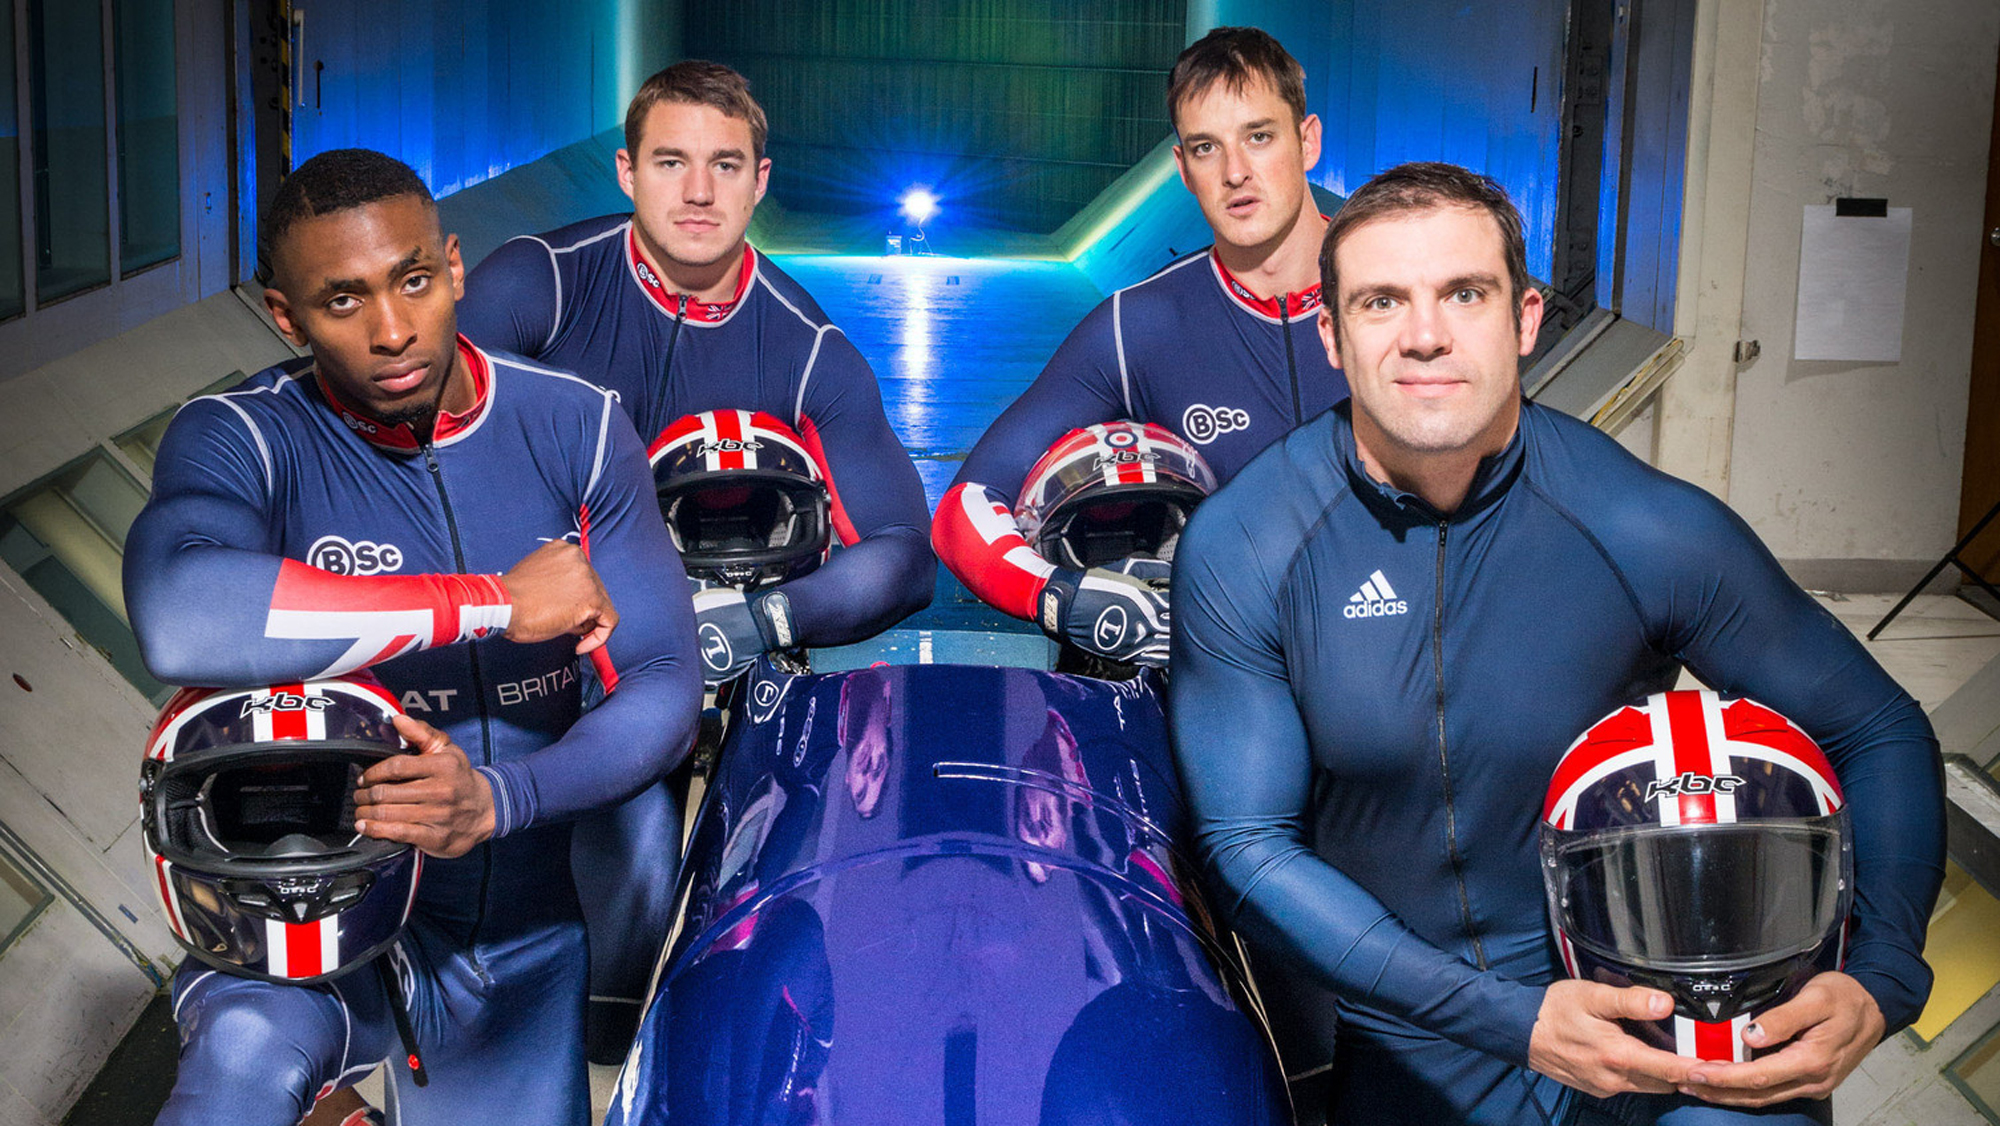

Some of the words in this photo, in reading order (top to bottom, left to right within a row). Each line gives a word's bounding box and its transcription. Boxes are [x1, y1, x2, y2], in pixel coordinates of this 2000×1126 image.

[1182, 403, 1250, 445] BSc
[306, 535, 403, 576] BSc
[1343, 599, 1408, 619] adidas
